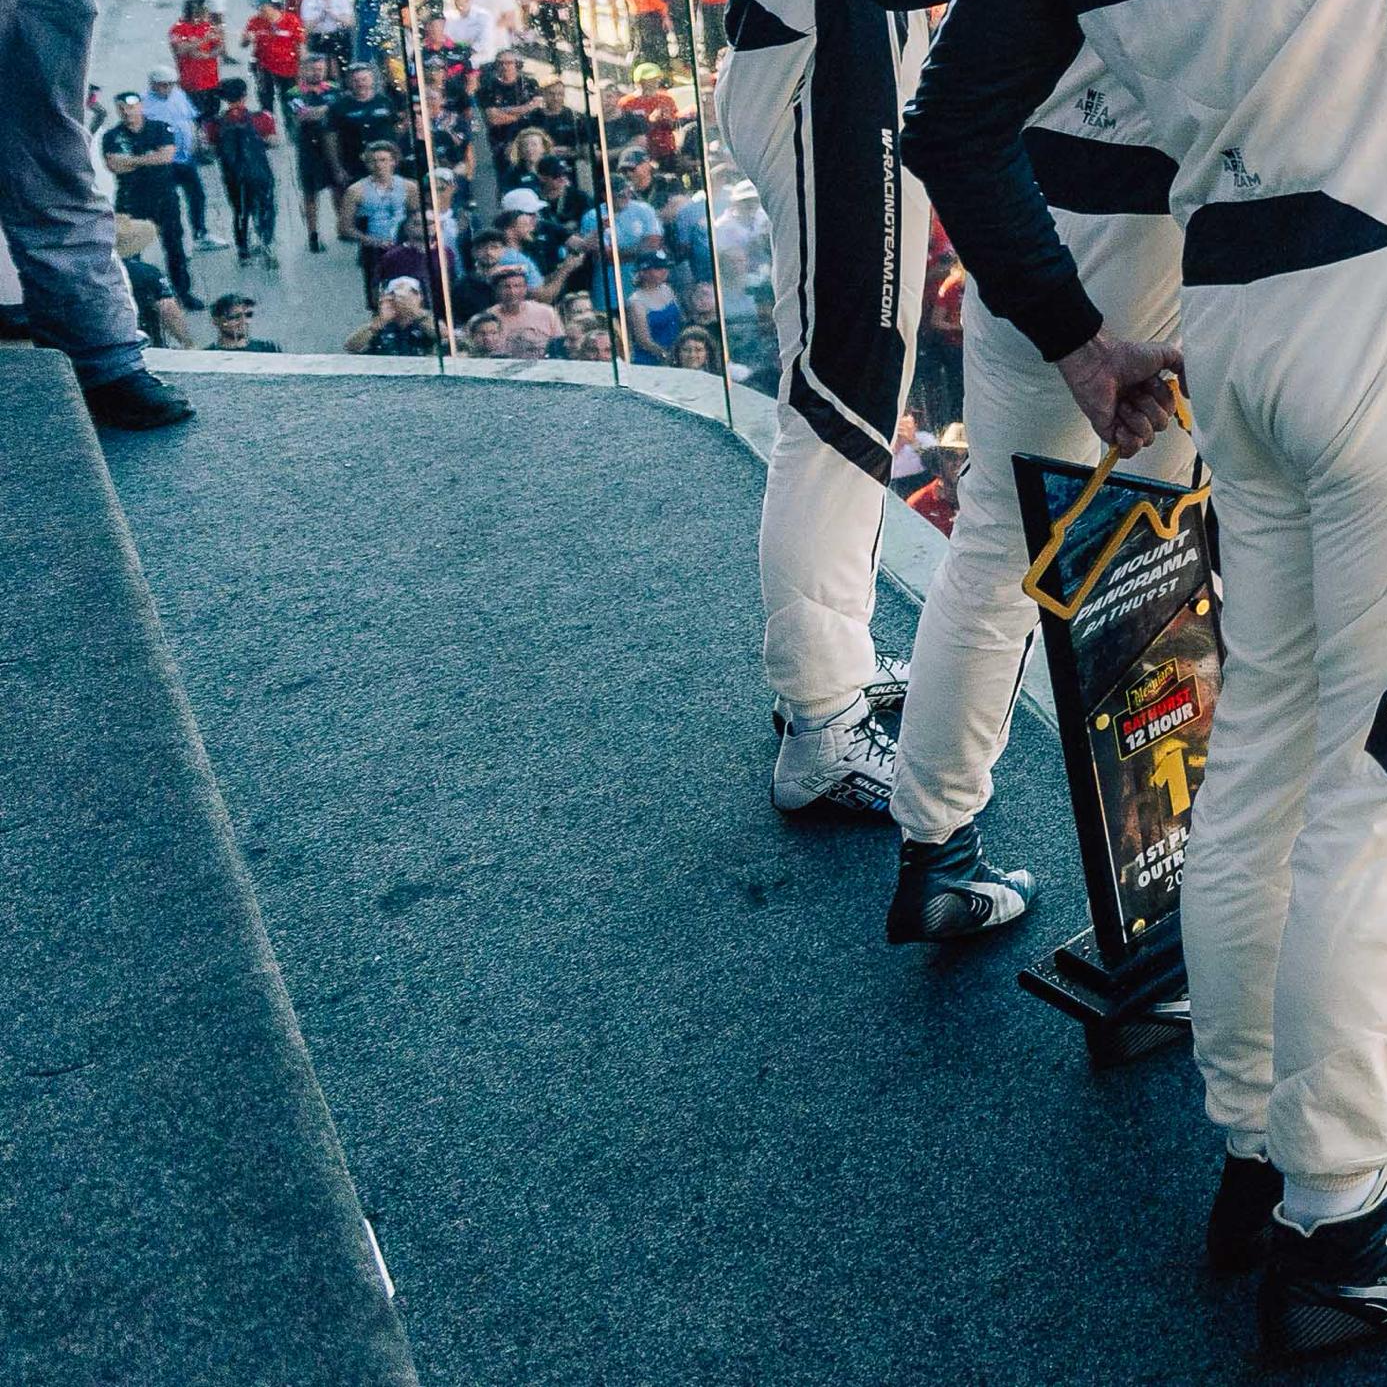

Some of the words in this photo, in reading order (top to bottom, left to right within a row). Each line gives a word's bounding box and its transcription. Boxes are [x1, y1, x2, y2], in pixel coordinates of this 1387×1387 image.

[1083, 112, 1117, 130] TEAM
[881, 128, 896, 328] W-RACINGTEAM.COM
[1108, 529, 1191, 586] MOUNT
[1073, 548, 1198, 626] PANORAMA
[1081, 577, 1180, 639] BATHURST
[1122, 687, 1193, 735] BATHURST
[1125, 729, 1147, 751] 12
[1147, 702, 1194, 741] HOUR
[1135, 839, 1166, 868] 1ST
[1168, 826, 1190, 850] PL
[1138, 849, 1186, 887] OUTR
[1165, 869, 1184, 893] 20
